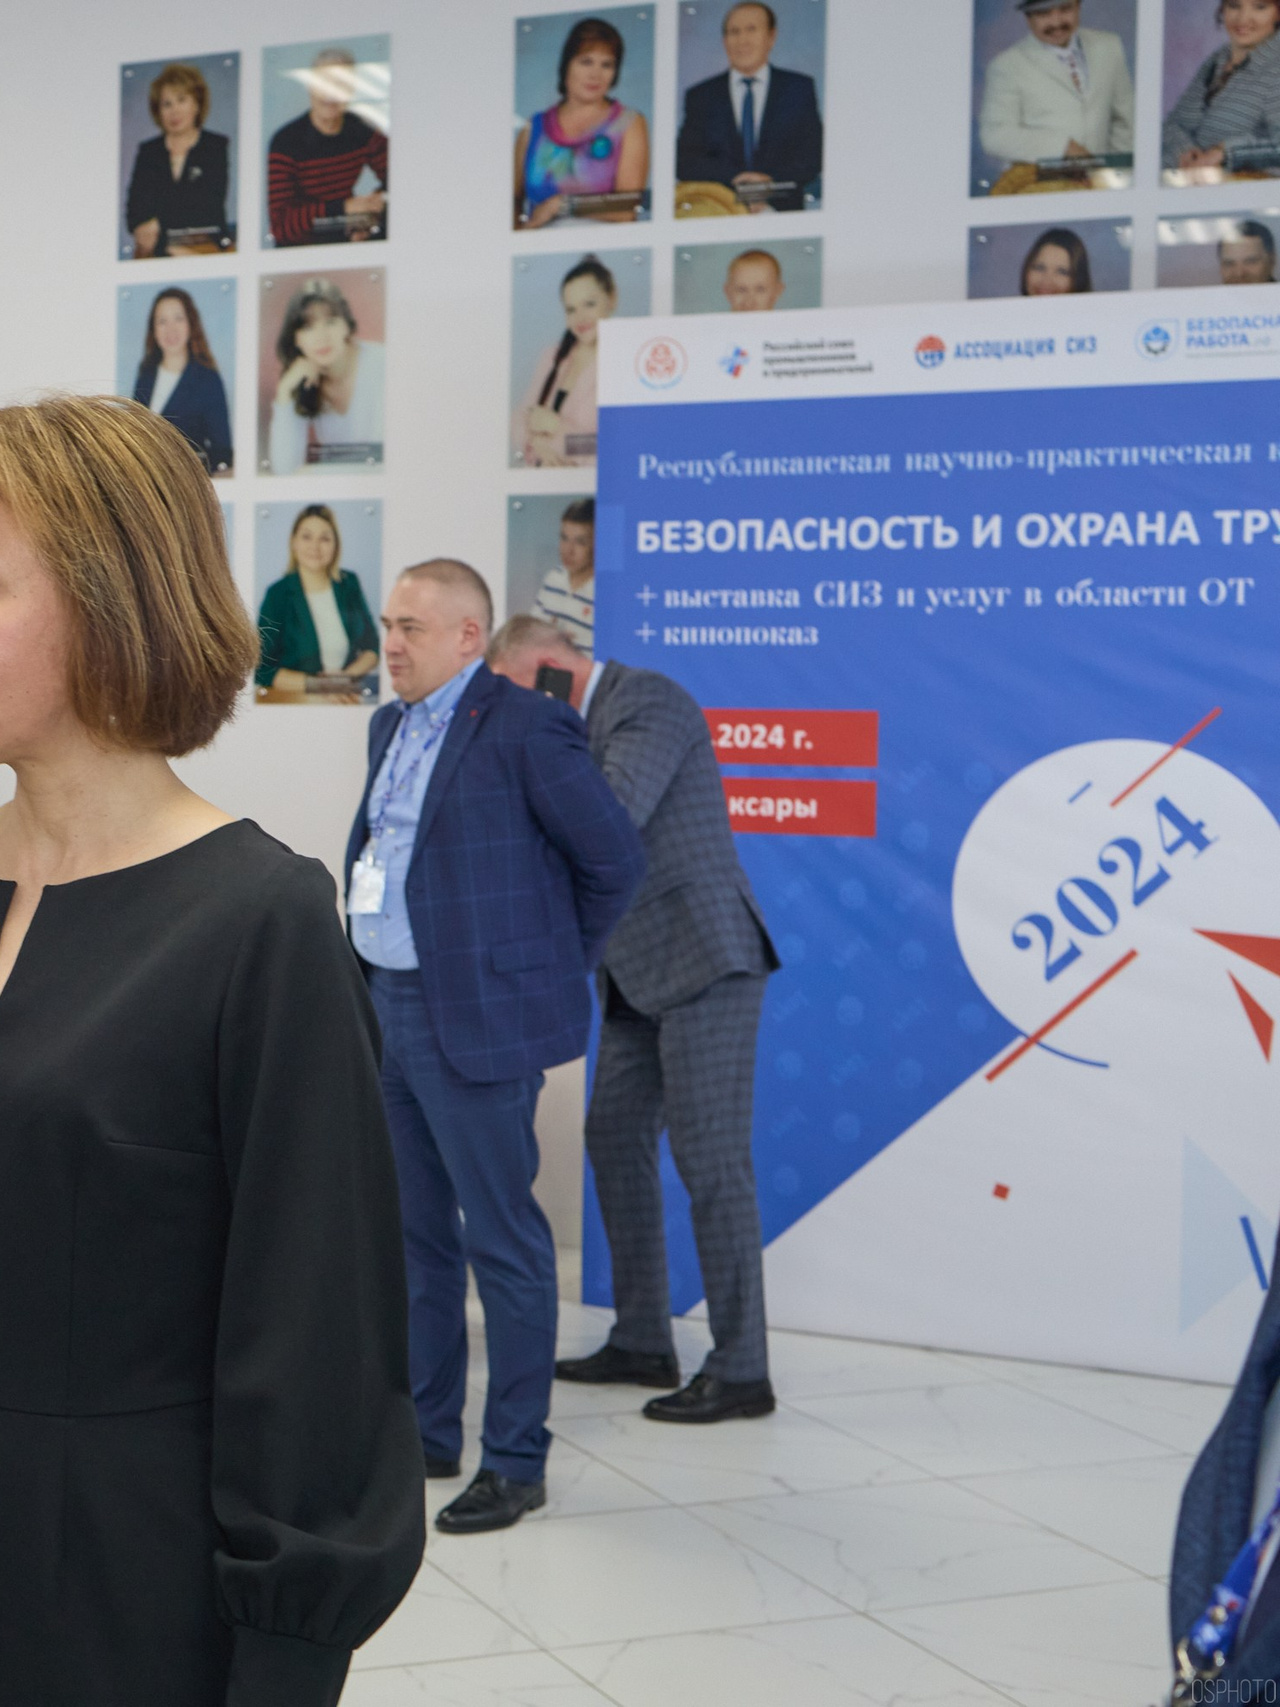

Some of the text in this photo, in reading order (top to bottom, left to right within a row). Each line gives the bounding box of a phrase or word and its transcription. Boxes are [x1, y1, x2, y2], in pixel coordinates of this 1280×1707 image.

[955, 338, 1054, 360] АССОЦИАЦИЯ
[1066, 336, 1096, 354] СИЗ
[1186, 333, 1249, 348] РАБОТА
[638, 451, 891, 484] Республиканская
[905, 443, 1252, 478] научно-практическая
[637, 515, 959, 552] БЕЗОПАСНОСТЬ
[972, 514, 1002, 549] И
[1016, 511, 1201, 548] ОХРАНА
[814, 579, 883, 608] СИЗ
[897, 587, 915, 608] и
[925, 586, 1011, 614] услуг
[1024, 587, 1042, 608] в
[1055, 577, 1186, 608] области
[1199, 576, 1255, 607] ОТ
[793, 729, 814, 750] г.
[1012, 796, 1220, 983] 2024
